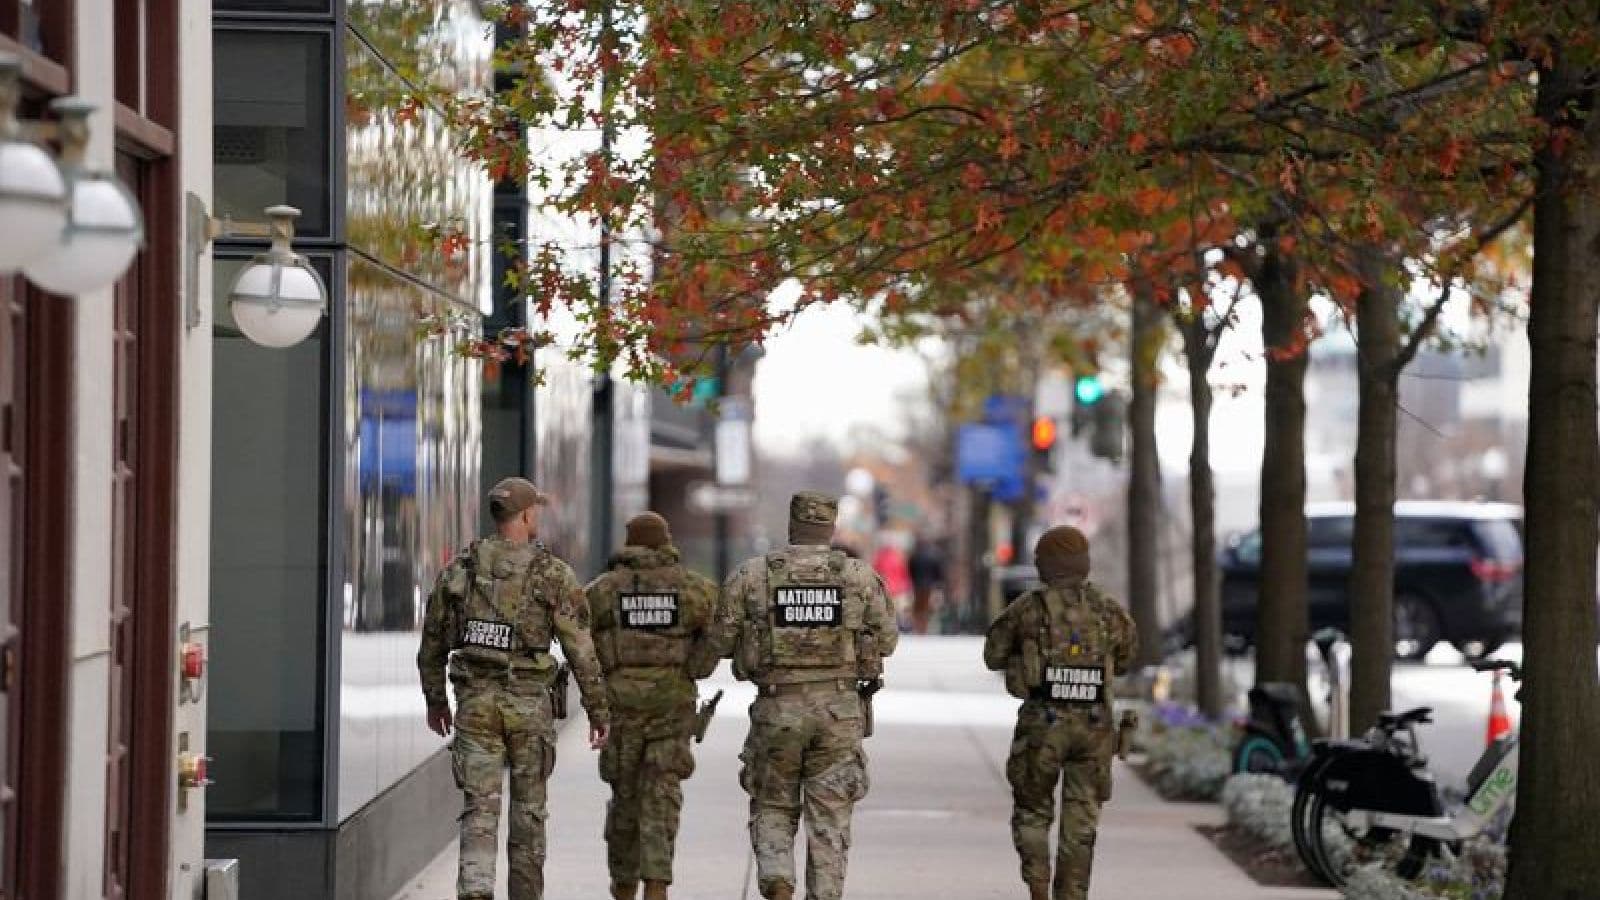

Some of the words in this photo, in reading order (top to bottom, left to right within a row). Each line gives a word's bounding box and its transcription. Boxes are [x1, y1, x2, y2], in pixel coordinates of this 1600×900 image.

[622, 596, 677, 610] NATIONAL
[778, 588, 840, 605] NATIONAL
[629, 610, 672, 625] GUARD
[785, 606, 833, 622] GUARD
[1046, 667, 1102, 685] NATIONAL
[1051, 684, 1097, 701] GUARD
